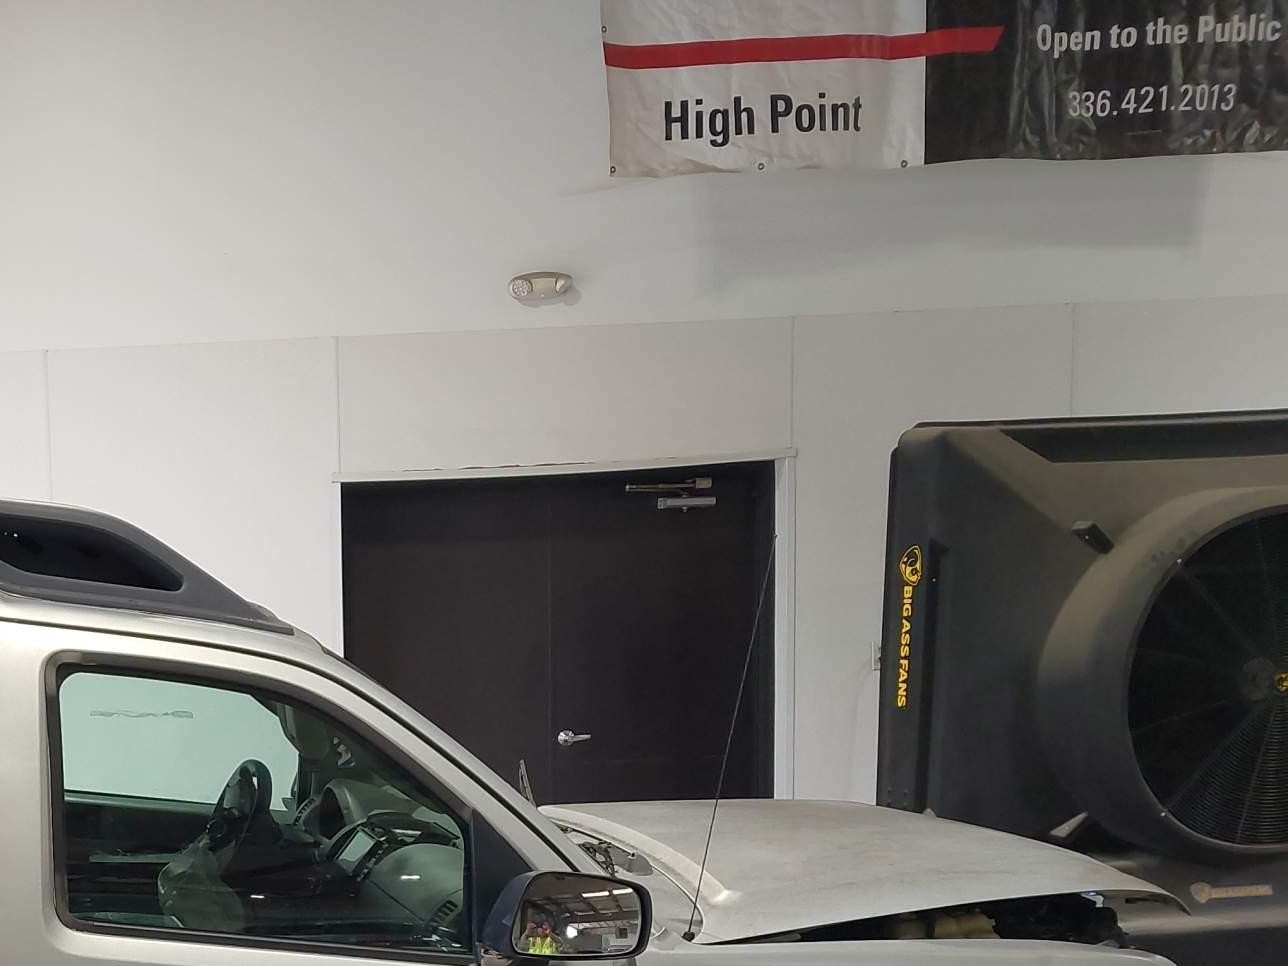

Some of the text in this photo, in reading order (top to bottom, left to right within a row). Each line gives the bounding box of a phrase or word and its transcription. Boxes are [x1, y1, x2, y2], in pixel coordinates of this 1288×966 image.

[1037, 13, 1282, 59] Open to the Public
[664, 93, 863, 148] High Point
[1068, 83, 1237, 118] 336.421.2013
[897, 585, 913, 708] BIG ASS FANS
